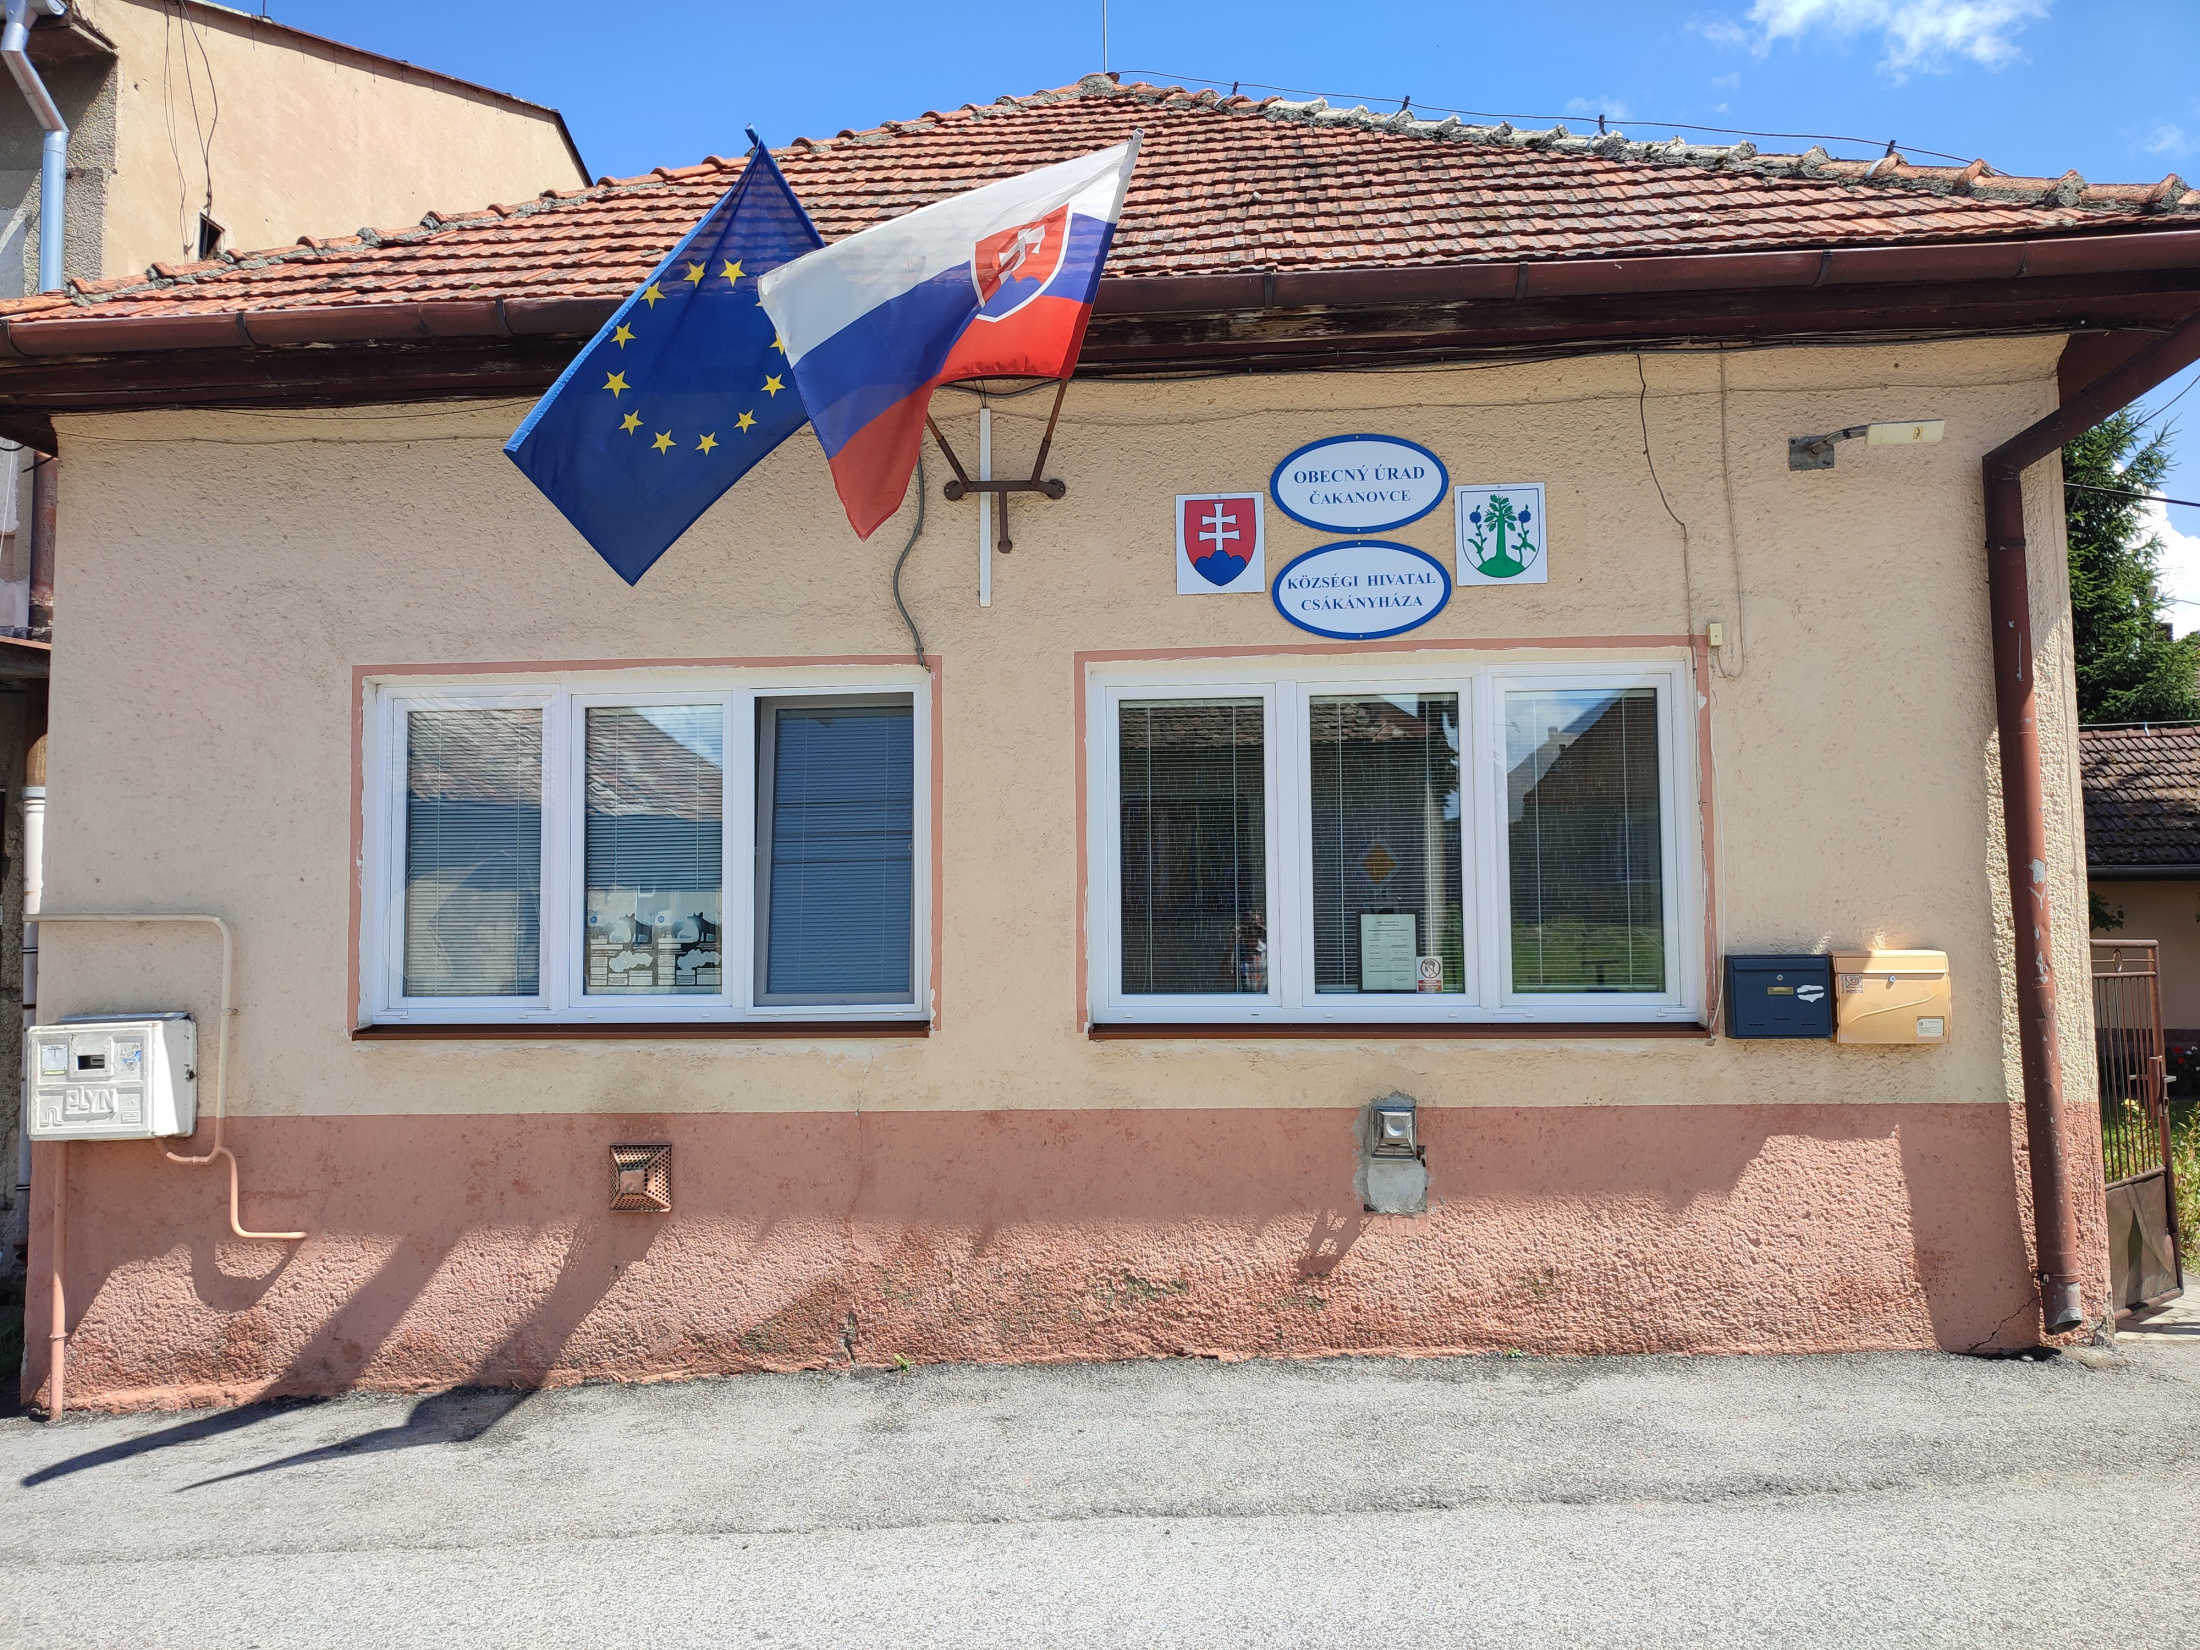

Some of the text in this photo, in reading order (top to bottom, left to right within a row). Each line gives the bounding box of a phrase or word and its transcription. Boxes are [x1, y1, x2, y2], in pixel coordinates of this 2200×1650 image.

[1294, 464, 1425, 483] OBECNÝ ÚRAD
[1309, 490, 1411, 505] ČAKANOVCE
[1287, 573, 1436, 590] KÖZSÉGI HIVATAL
[1301, 593, 1423, 611] CSÁKÁNYHÁZA
